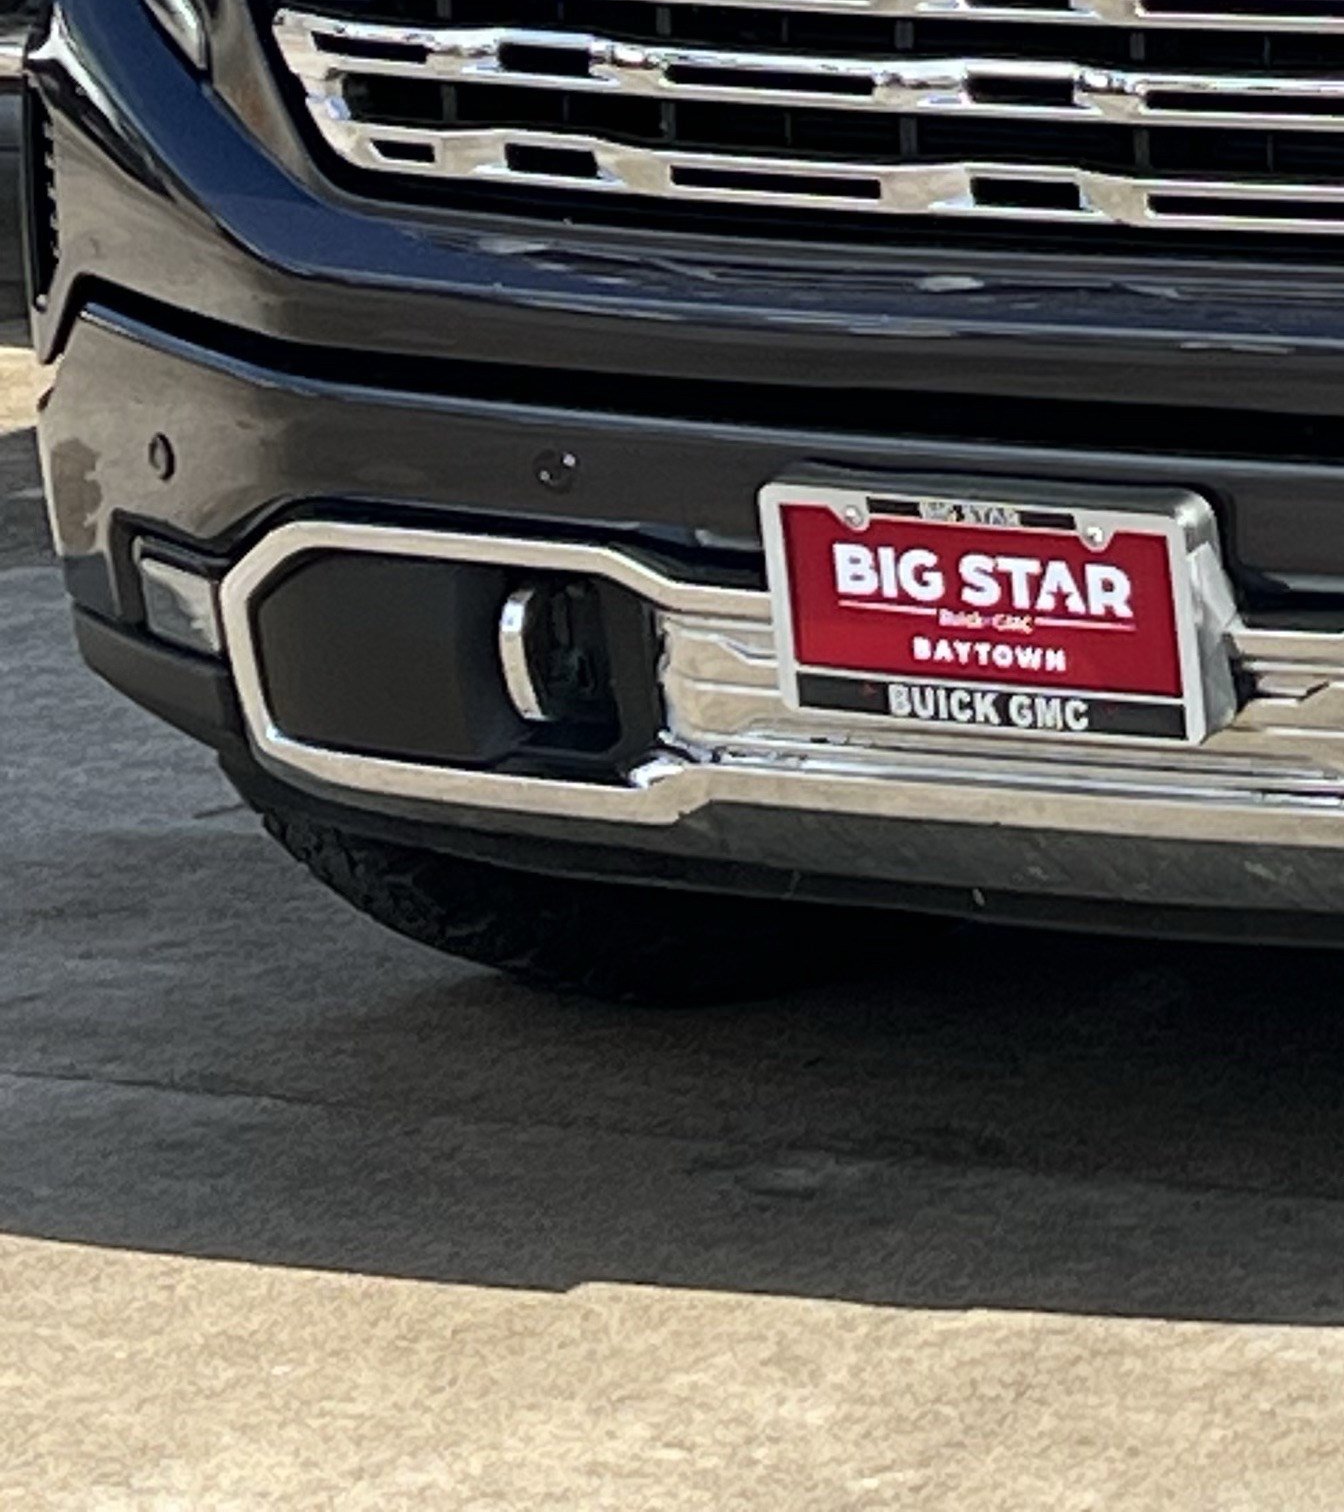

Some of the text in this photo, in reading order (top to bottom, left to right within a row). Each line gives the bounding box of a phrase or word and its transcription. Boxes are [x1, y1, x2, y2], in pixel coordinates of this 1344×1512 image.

[832, 543, 1134, 618] BIG STAR
[912, 636, 1067, 672] BAYTOWN
[888, 684, 1090, 731] BUICK GMC
